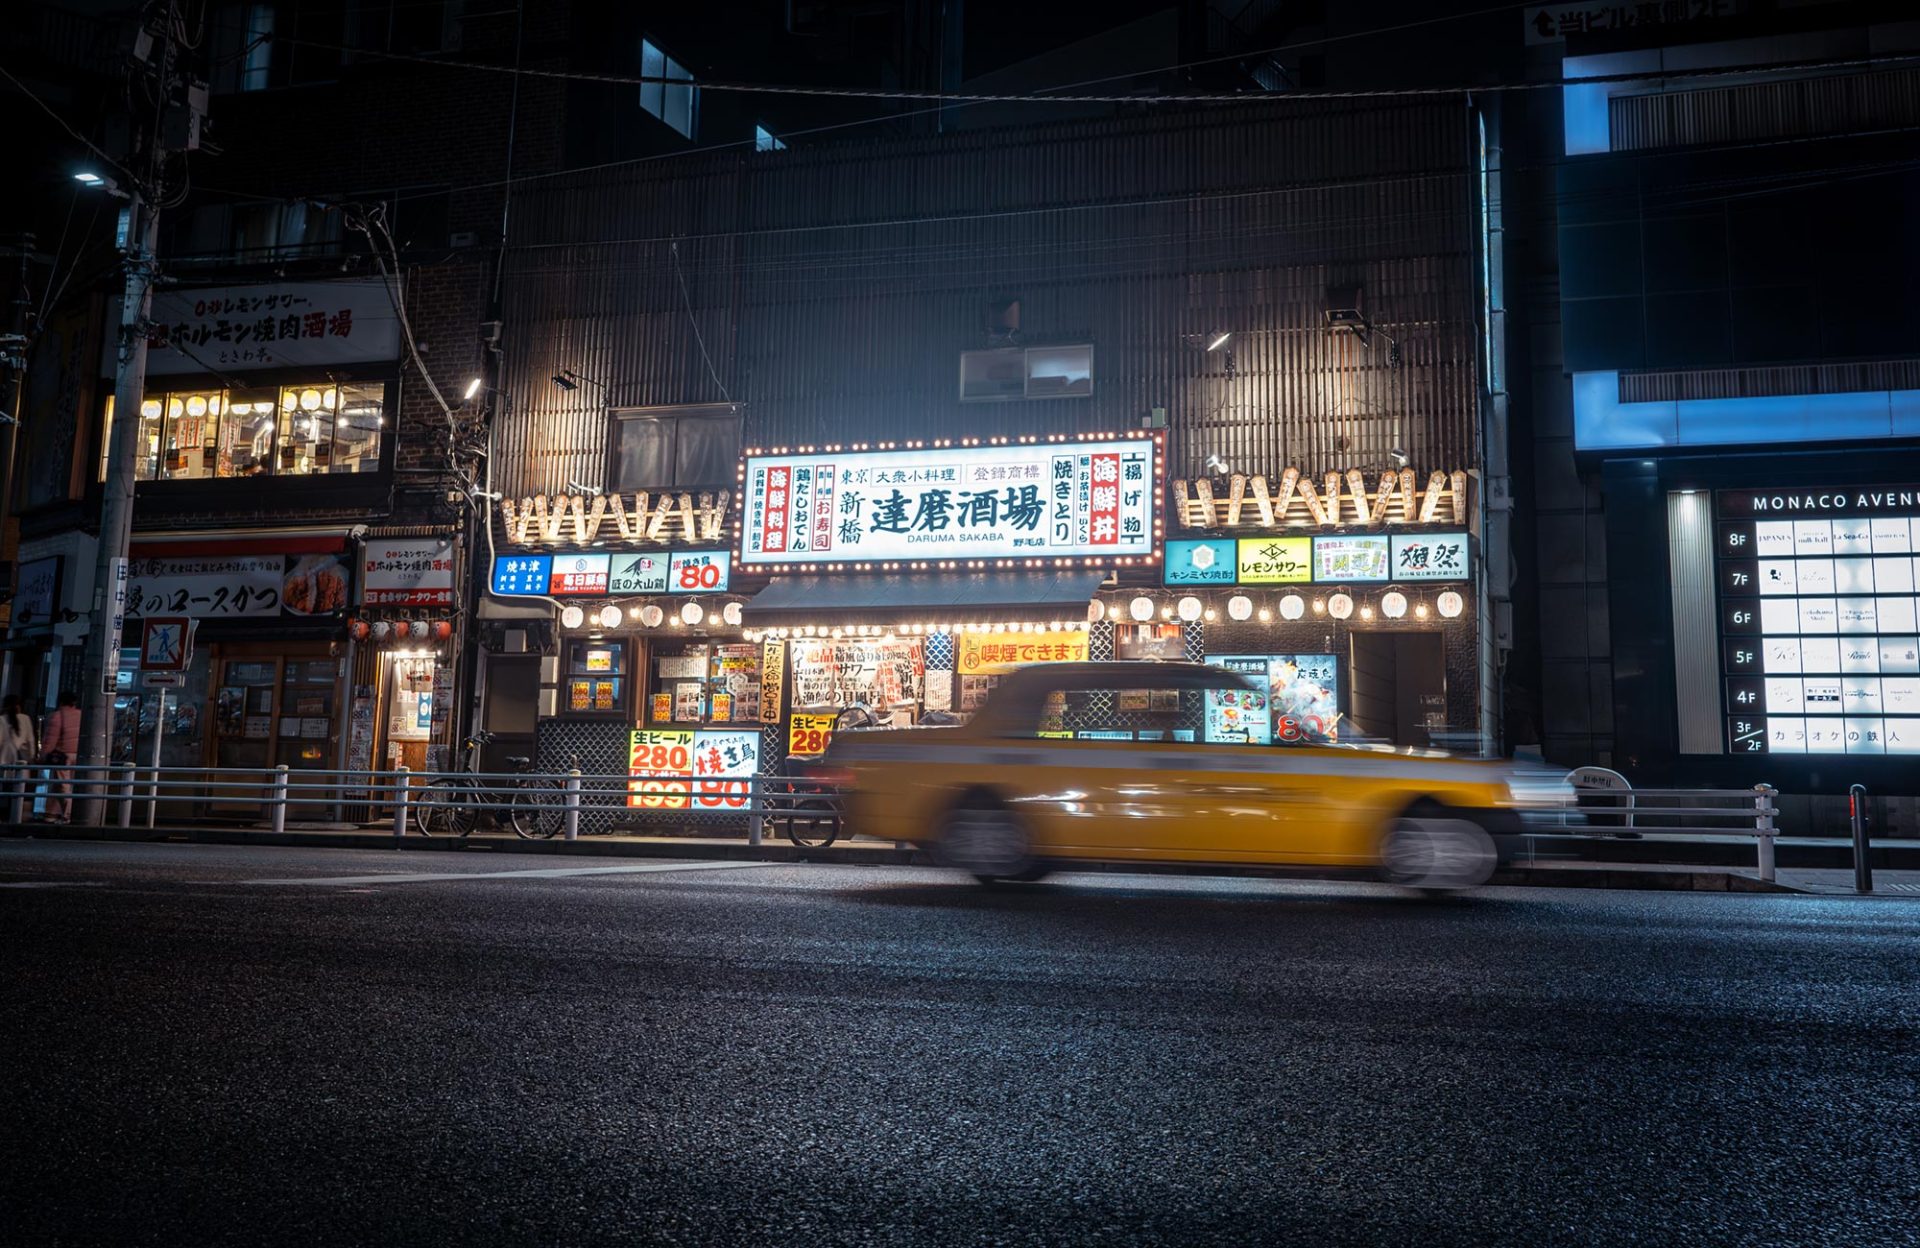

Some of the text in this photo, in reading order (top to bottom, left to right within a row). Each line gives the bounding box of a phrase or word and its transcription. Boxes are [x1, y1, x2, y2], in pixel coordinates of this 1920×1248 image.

[840, 468, 869, 485] 東京
[876, 468, 956, 483] 大衆小料理
[974, 464, 1041, 481] 登録商標
[1054, 460, 1073, 541] 焼きとり
[1079, 471, 1089, 512] お茶漬け
[1092, 457, 1117, 541] 海鮮丼
[1124, 463, 1143, 533] 揚げ物
[766, 470, 788, 549] 海鮮料理
[792, 468, 811, 550] 鶏だしおでん
[869, 484, 1047, 534] 達磨酒場
[1753, 494, 1847, 511] MONACO
[815, 501, 831, 548] お寿司
[837, 490, 867, 545] 新橋
[907, 532, 1004, 543] DARUMA SAKABA
[1079, 518, 1088, 543] いくら
[1729, 534, 1746, 546] 8F
[679, 564, 721, 589] 80
[1170, 570, 1234, 580] キンミヤ焼酎
[1241, 561, 1308, 573] レモンサワー
[1732, 574, 1748, 586] 7F
[1733, 612, 1752, 624] 6F
[981, 643, 1087, 663] 喫煙できます
[1736, 652, 1753, 664] 5F
[1737, 691, 1756, 703] 4F
[1278, 713, 1325, 742] 80
[1736, 721, 1752, 733] 3F
[1775, 730, 1901, 742] カラオケの鉄人
[634, 732, 692, 745] 生ビール
[1747, 740, 1762, 751] 2F
[632, 745, 688, 770] 280
[696, 743, 756, 776] 焼き鳥
[628, 780, 687, 808] 199
[699, 777, 750, 808] 80
